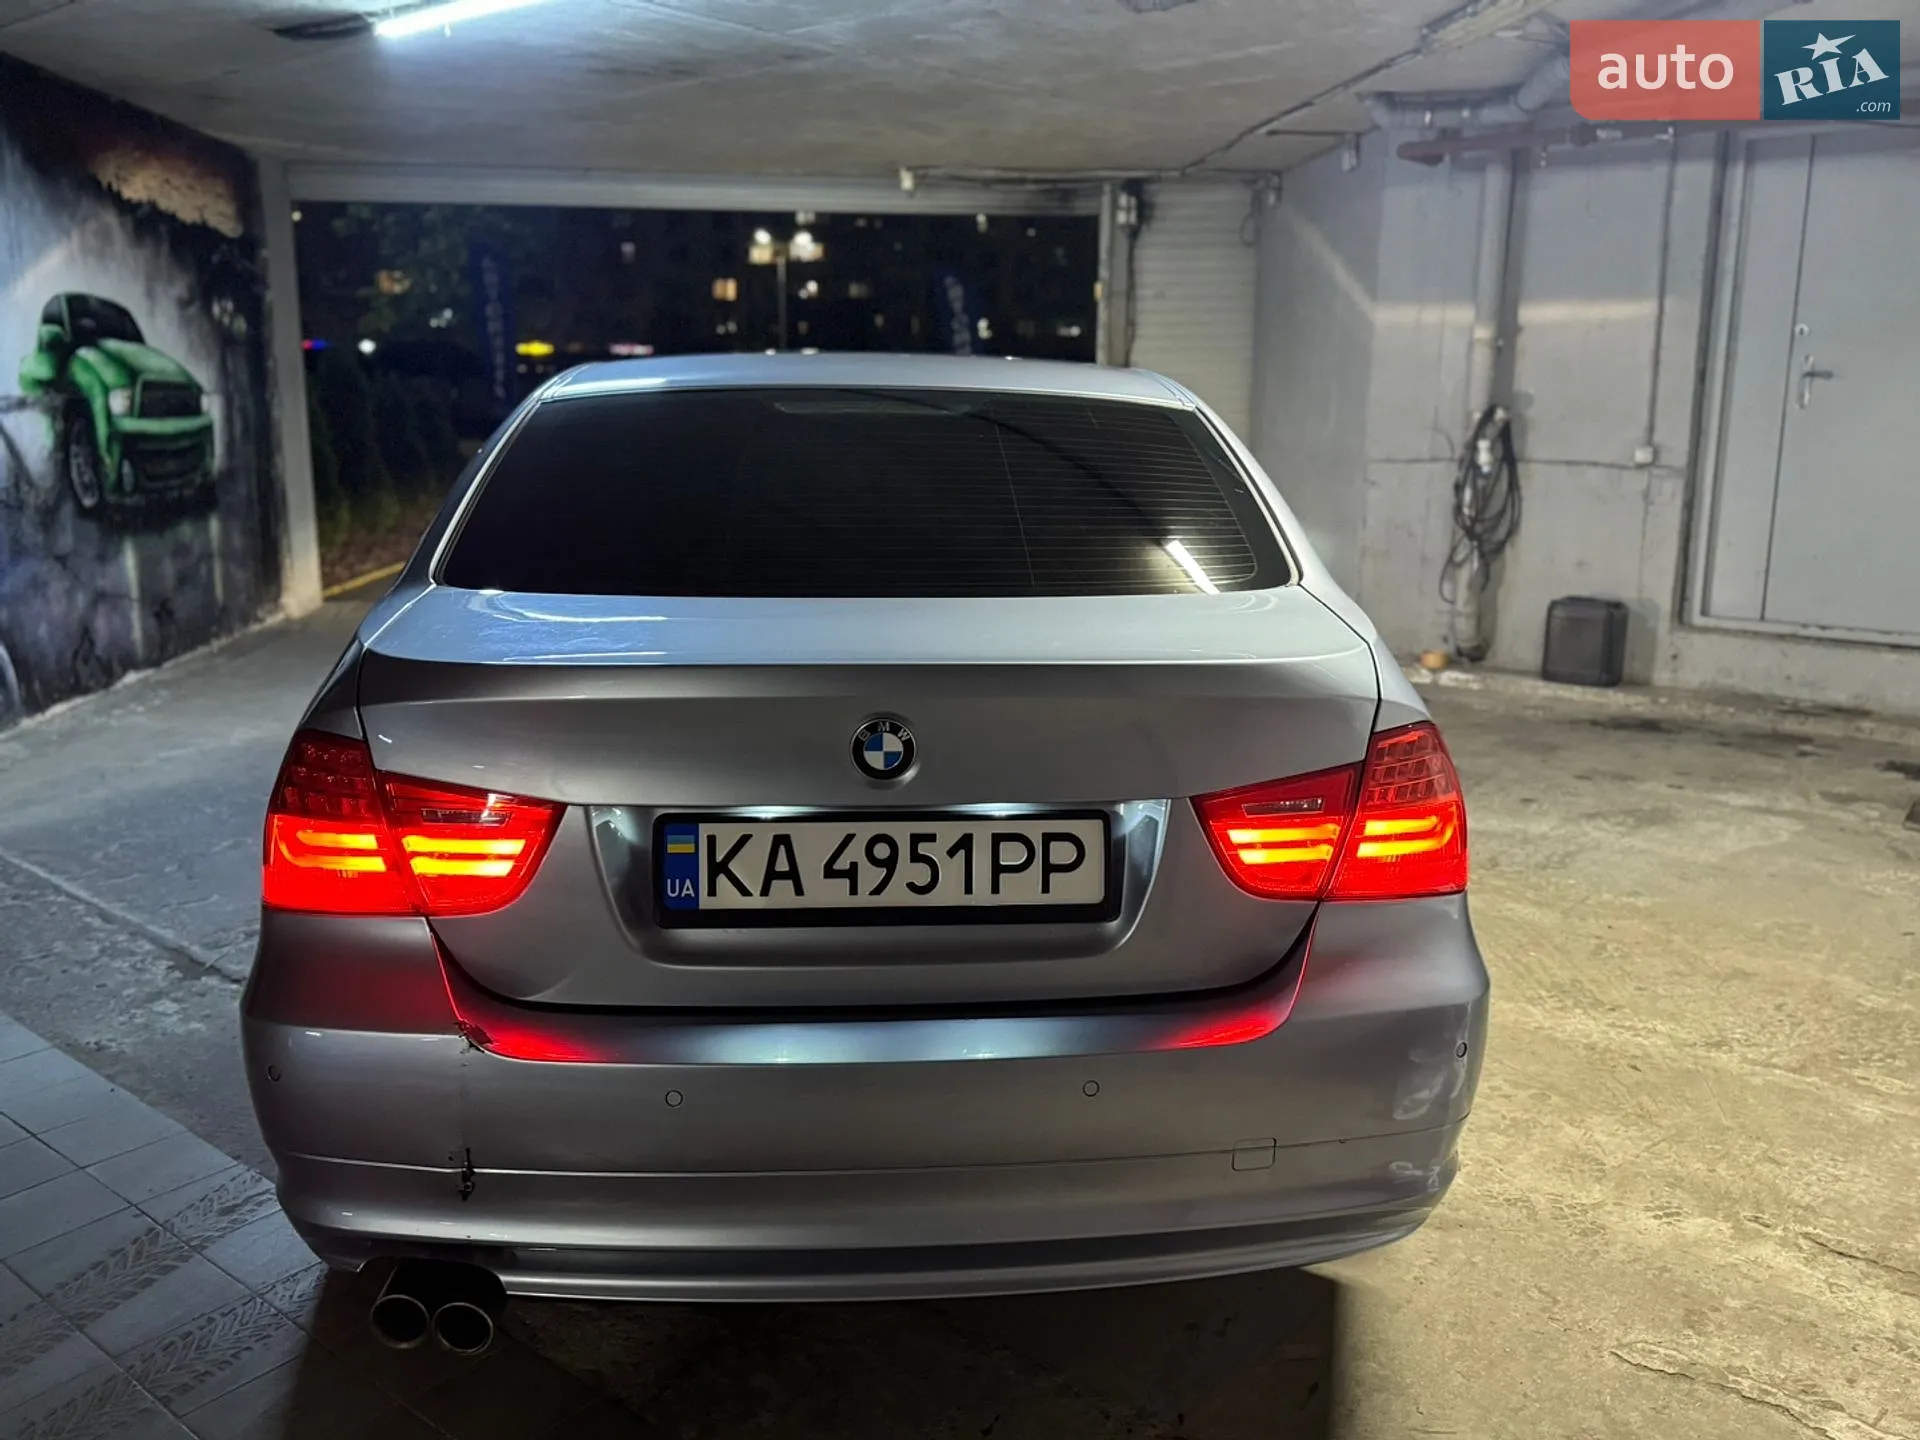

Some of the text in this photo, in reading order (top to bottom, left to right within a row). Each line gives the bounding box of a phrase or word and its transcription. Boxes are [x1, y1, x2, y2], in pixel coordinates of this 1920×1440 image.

[858, 721, 911, 742] BMW
[706, 833, 805, 898] KA
[666, 878, 695, 898] UA
